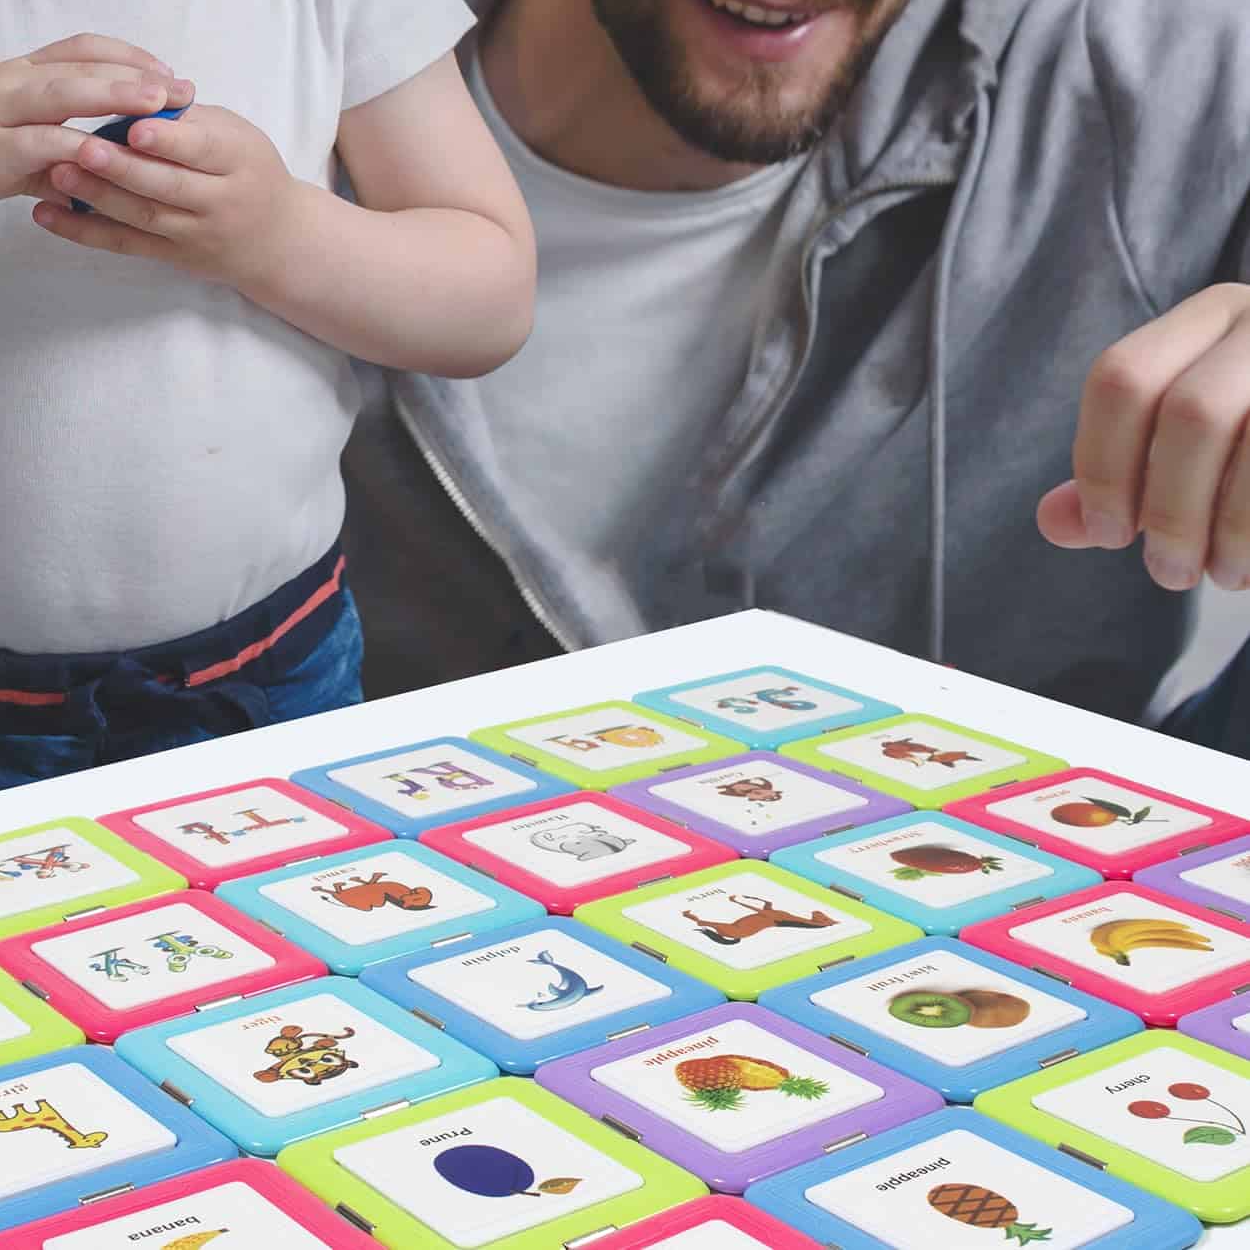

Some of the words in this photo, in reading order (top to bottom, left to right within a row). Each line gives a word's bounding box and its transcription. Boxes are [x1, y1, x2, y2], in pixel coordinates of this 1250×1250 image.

[686, 886, 727, 903] horse
[1060, 905, 1113, 925] banana
[461, 945, 521, 967] dolphin
[868, 974, 902, 992] fruit
[903, 964, 937, 984] kiwi
[241, 1015, 284, 1031] tiger
[644, 1035, 719, 1069] pineapple
[1106, 1073, 1151, 1097] cherry
[419, 1126, 474, 1148] Prune
[876, 1157, 951, 1192] pineapple
[128, 1214, 201, 1243] banana
